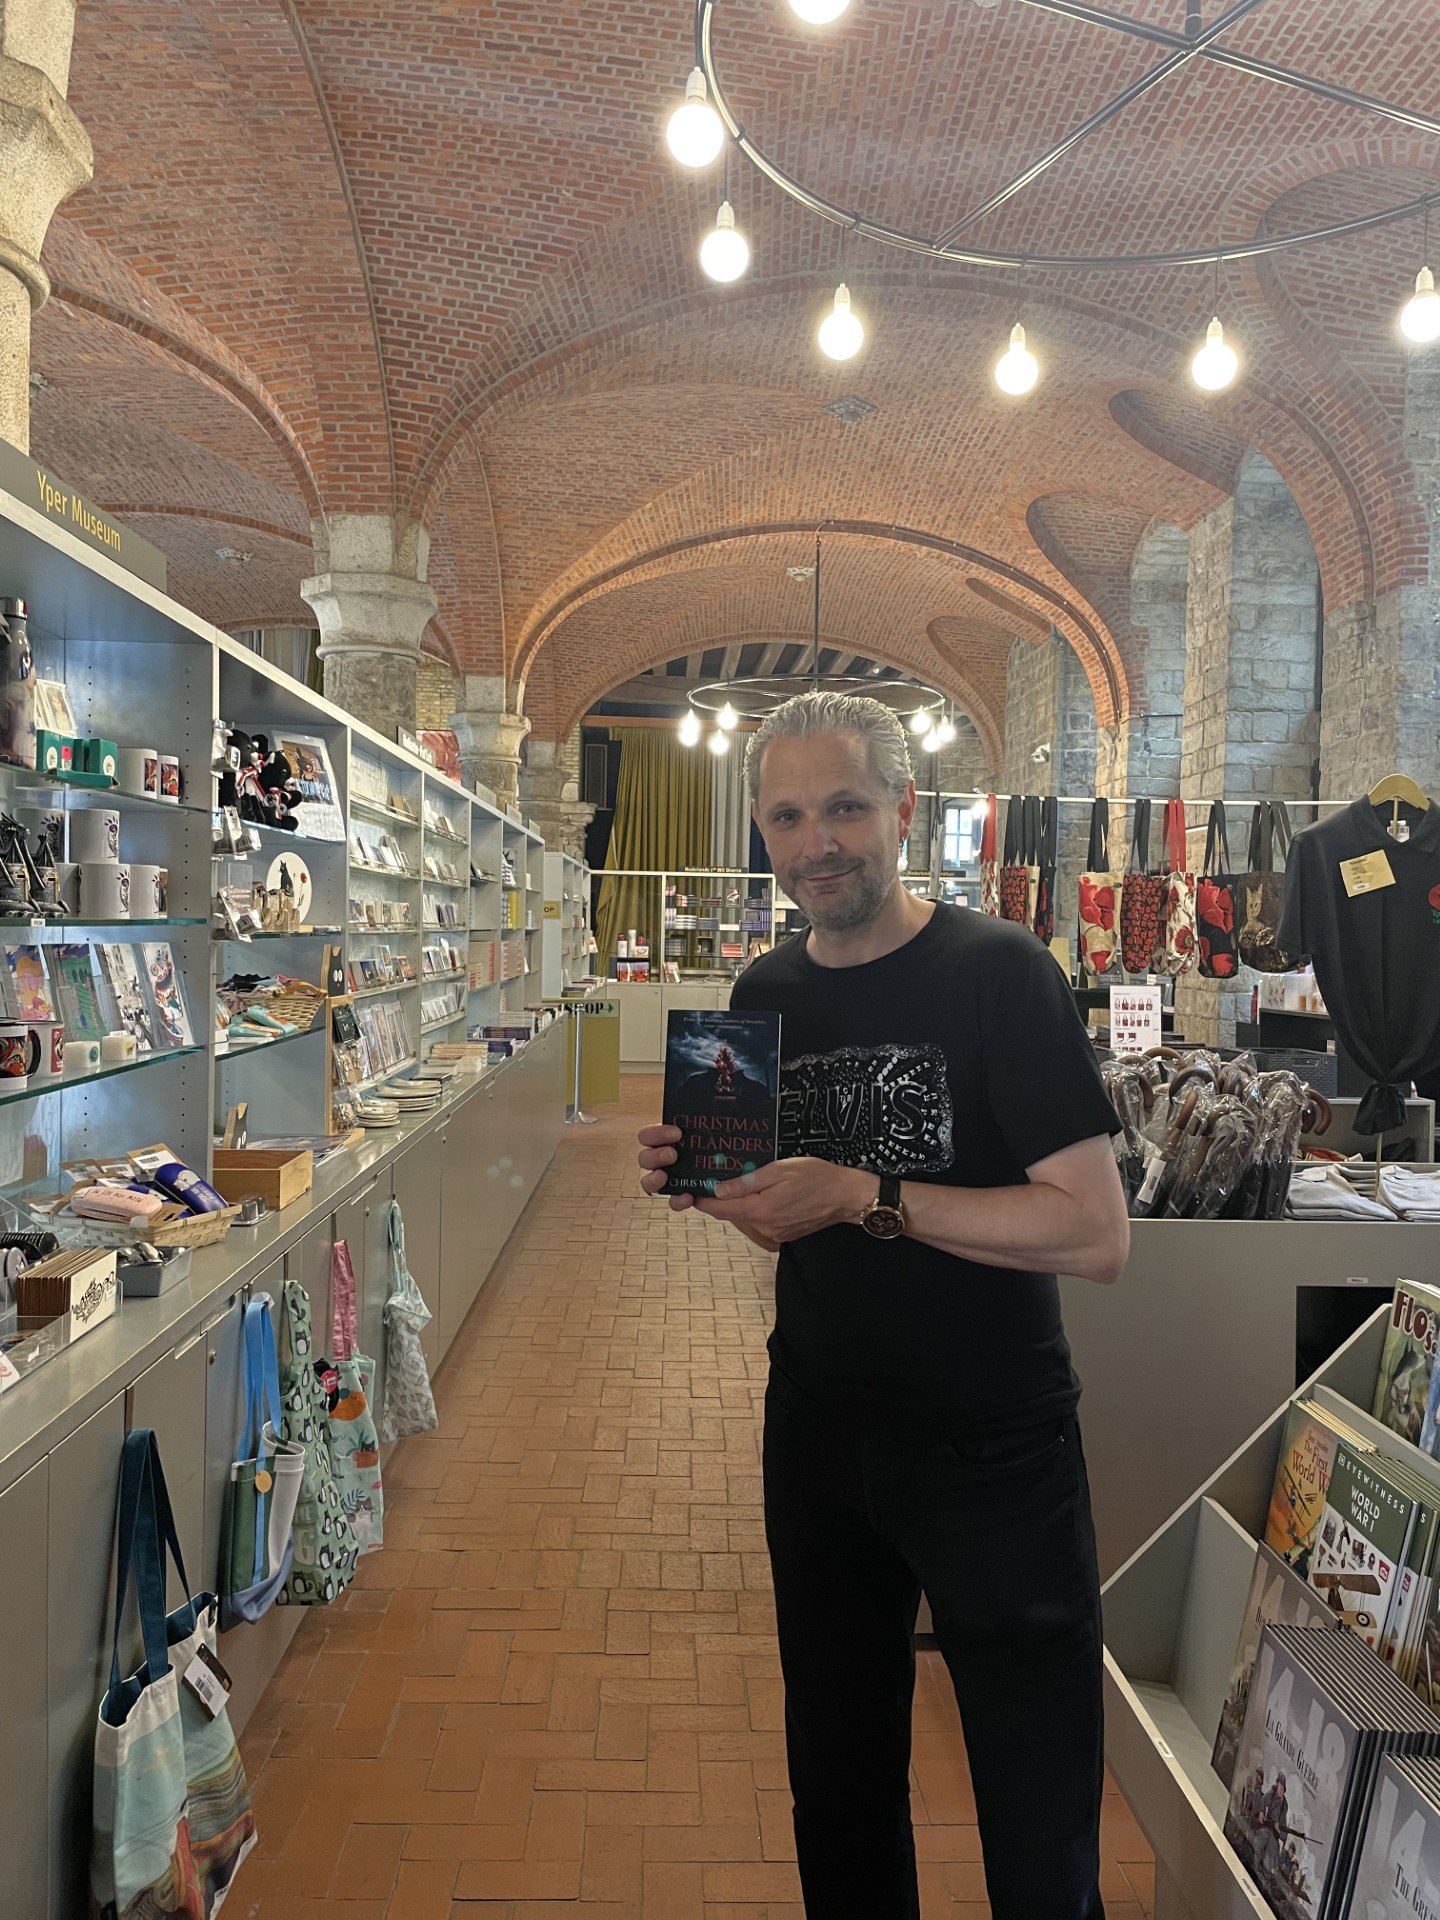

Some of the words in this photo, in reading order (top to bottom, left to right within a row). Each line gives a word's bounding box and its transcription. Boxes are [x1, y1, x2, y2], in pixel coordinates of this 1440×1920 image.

[37, 470, 67, 515] Yper
[72, 495, 120, 552] Museum
[673, 1114, 769, 1132] CHRISTMAS
[690, 1135, 774, 1153] FLANDERS
[695, 1155, 744, 1171] FIELDS
[669, 1178, 698, 1188] CHRIS
[1292, 1449, 1317, 1485] World
[1304, 1439, 1313, 1454] The
[1312, 1446, 1328, 1472] First
[1346, 1460, 1404, 1514] EYEWITNESS
[1351, 1485, 1380, 1520] WORLD
[1351, 1502, 1370, 1527] WAR
[1274, 1720, 1297, 1764] GRANDE
[1297, 1748, 1319, 1792] GUERRE
[1395, 1862, 1412, 1902] THE
